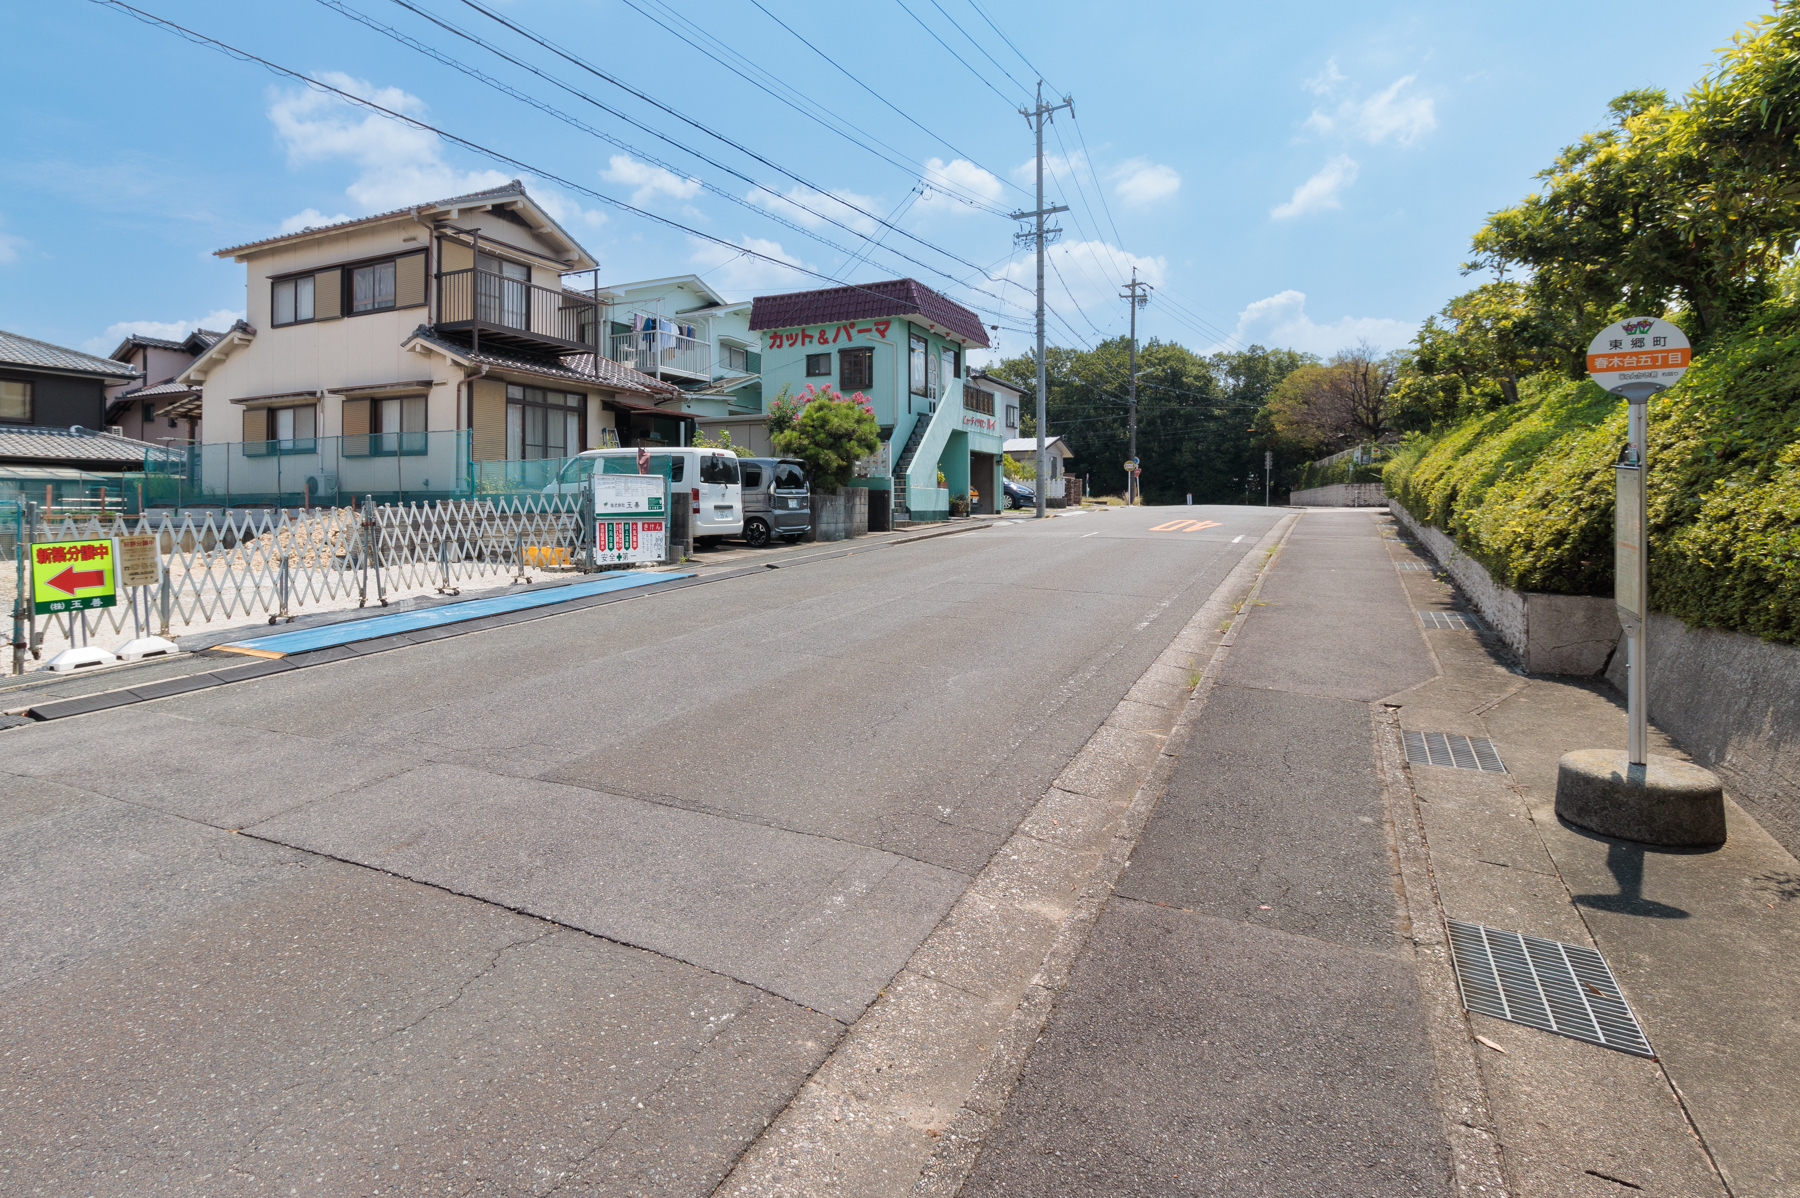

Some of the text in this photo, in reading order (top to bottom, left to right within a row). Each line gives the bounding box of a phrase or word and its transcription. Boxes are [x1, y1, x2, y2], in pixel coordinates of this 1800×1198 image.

[769, 320, 891, 349] カット&パーマ
[1609, 336, 1667, 350] 東郷町
[1594, 352, 1682, 369] 春木台五丁目
[643, 523, 661, 531] きけん
[36, 543, 109, 564] 新築分譲中
